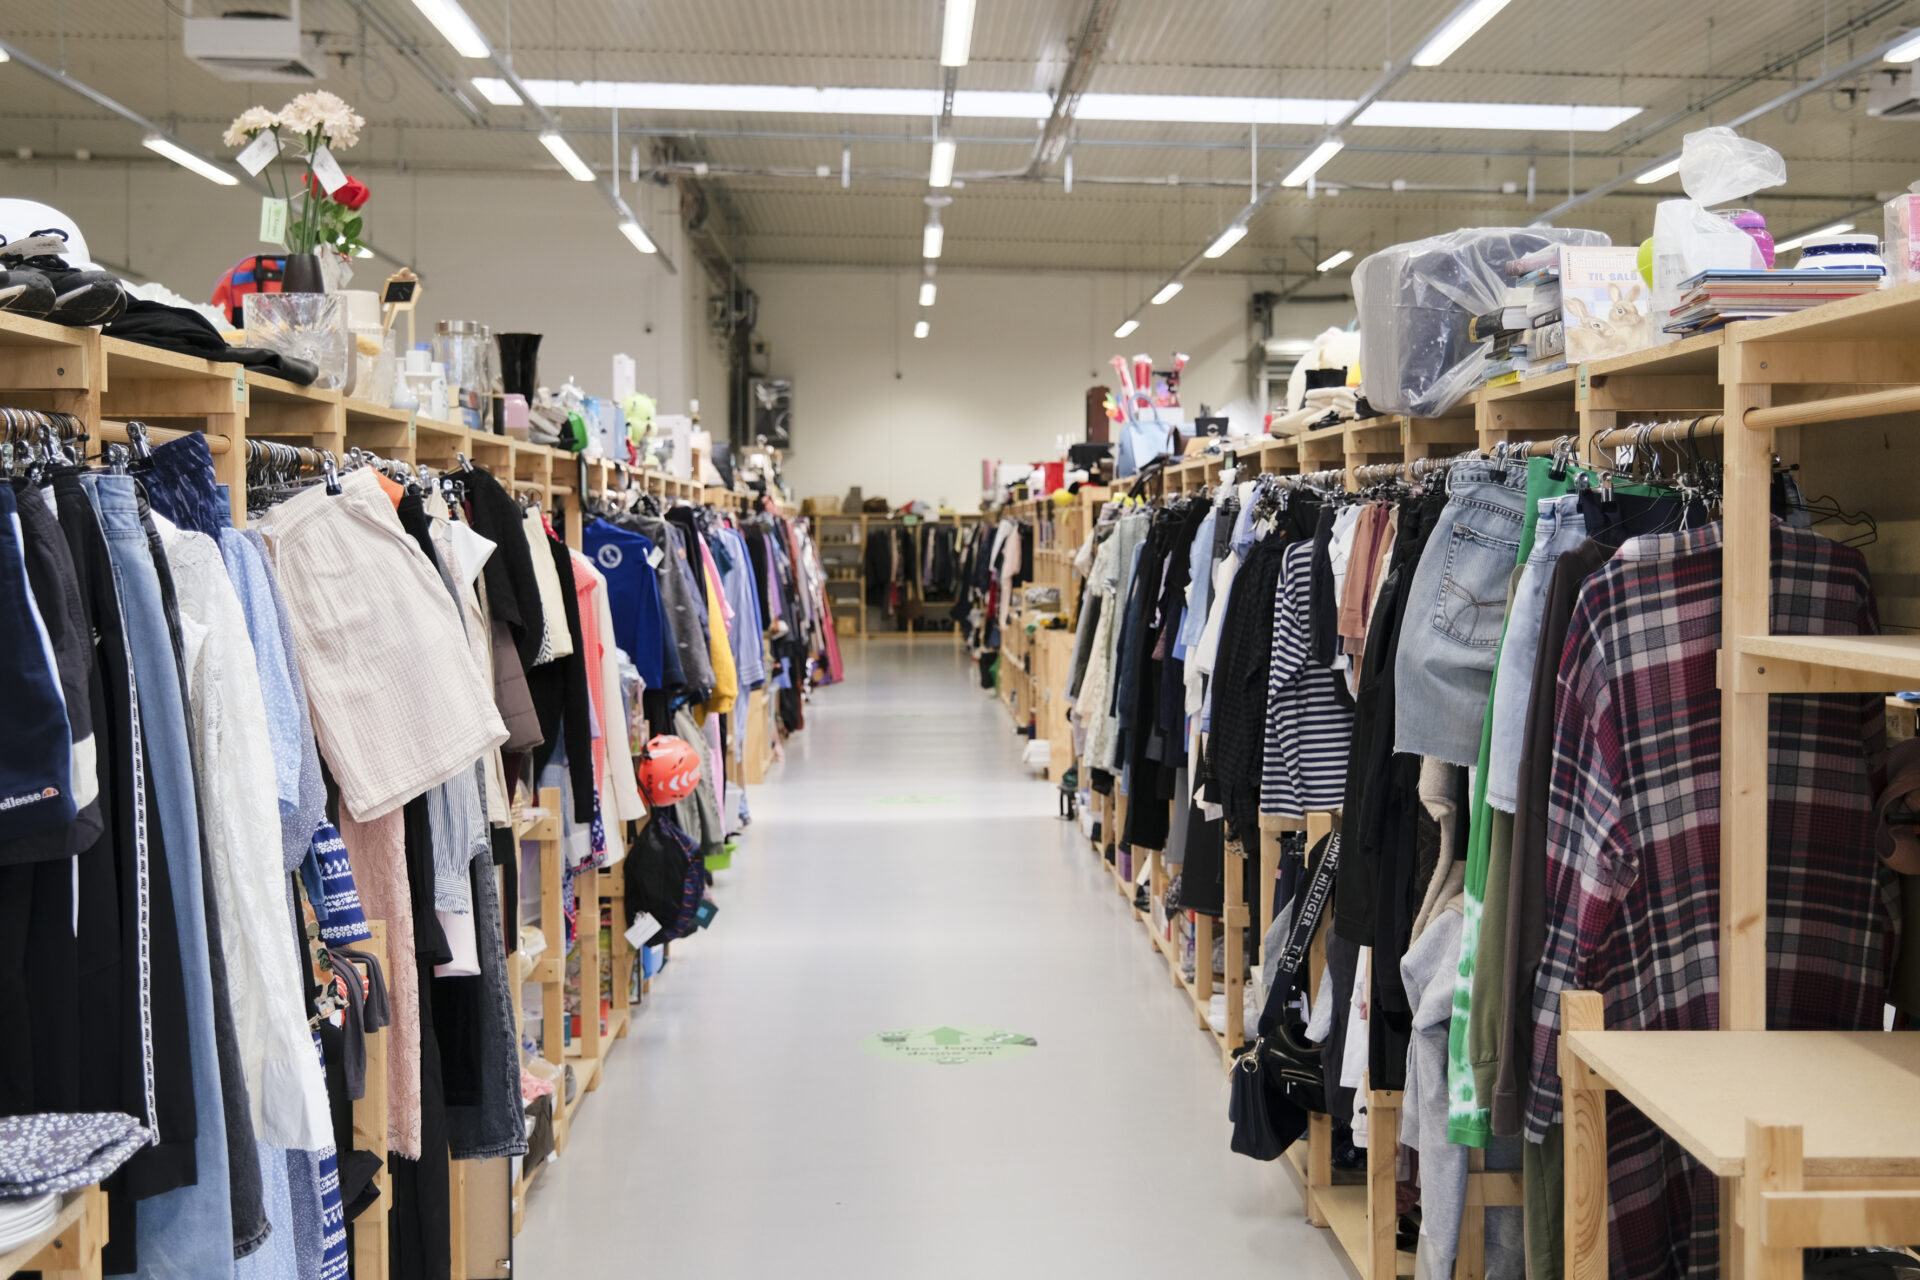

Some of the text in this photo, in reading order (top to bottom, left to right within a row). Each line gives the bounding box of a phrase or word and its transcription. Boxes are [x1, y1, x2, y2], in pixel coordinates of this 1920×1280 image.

[1588, 272, 1605, 281] TIL
[0, 792, 42, 810] ellesse
[1300, 873, 1329, 926] HILFIGER
